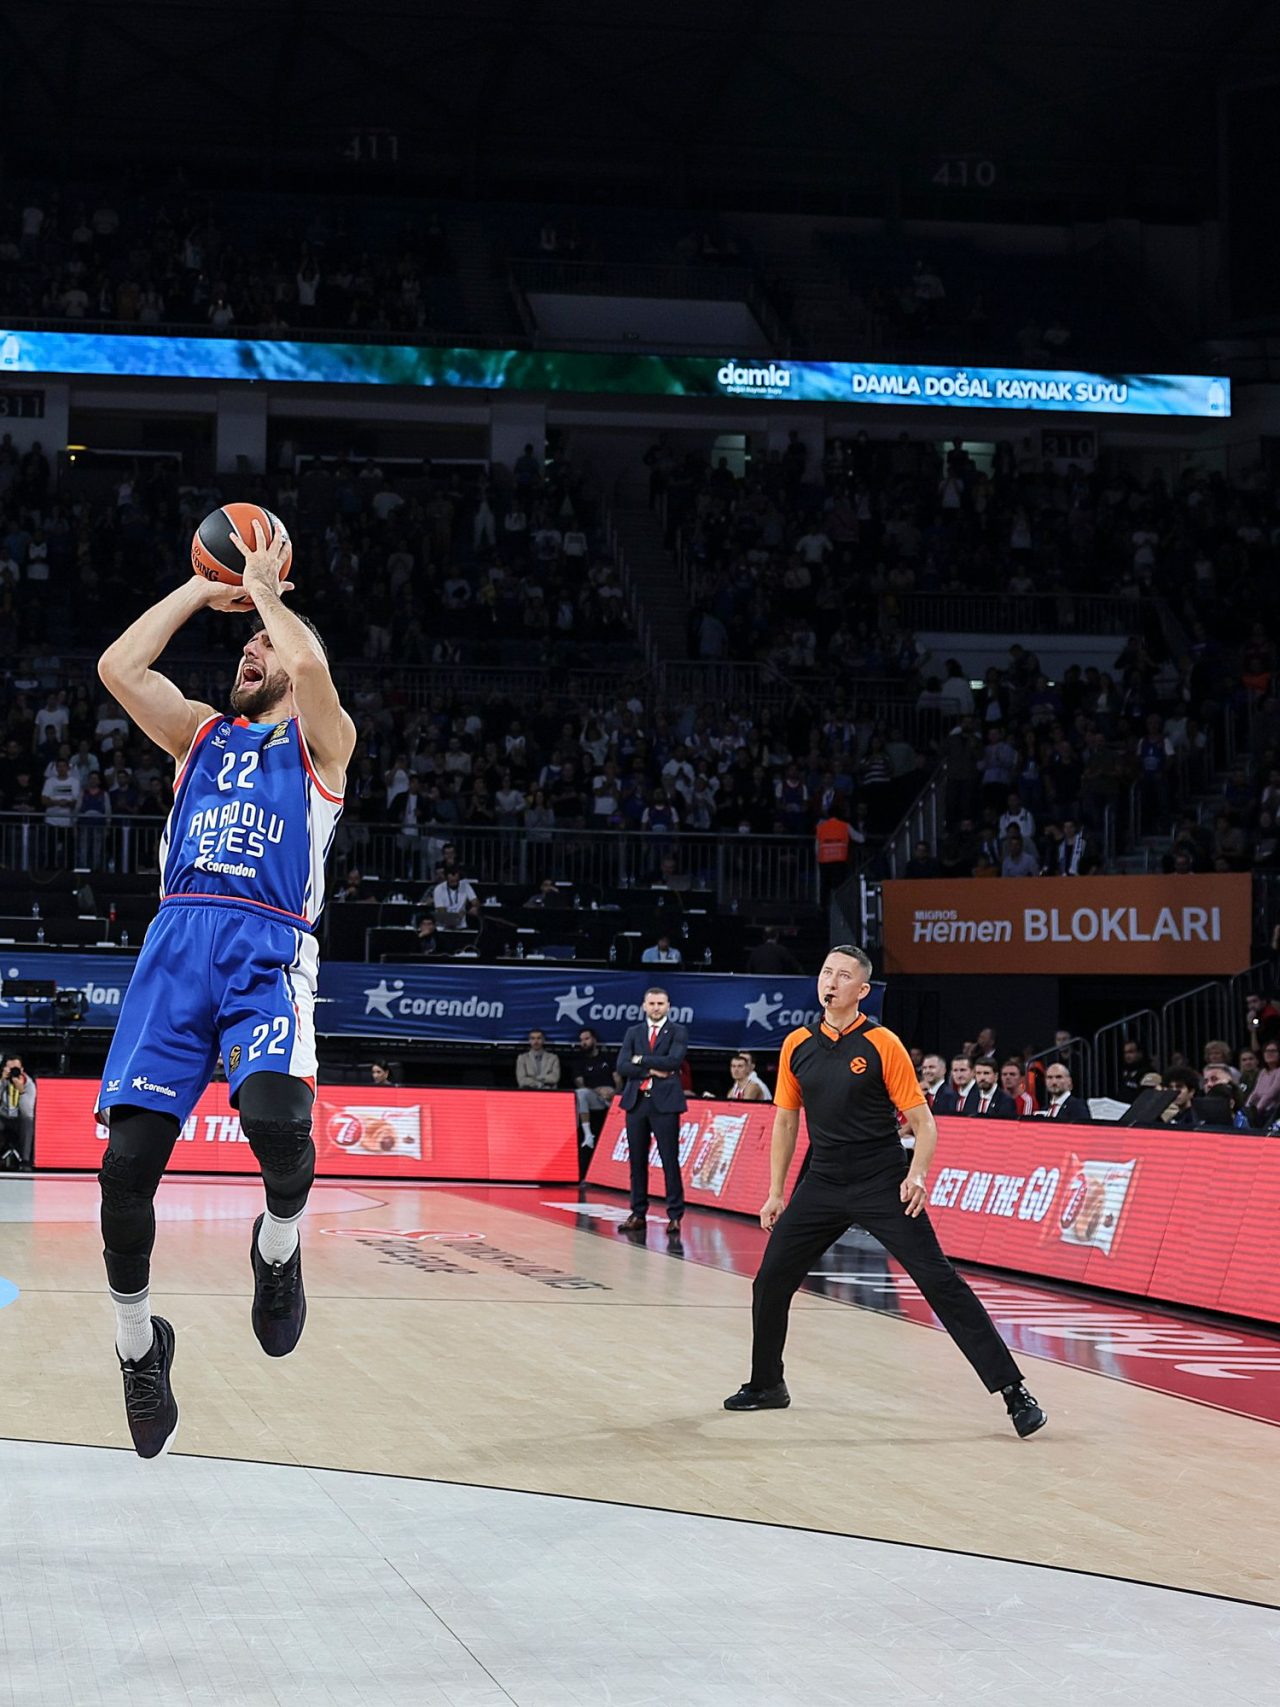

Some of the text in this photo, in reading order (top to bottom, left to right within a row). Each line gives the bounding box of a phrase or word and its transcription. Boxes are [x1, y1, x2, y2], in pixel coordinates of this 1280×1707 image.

[343, 135, 398, 162] 411
[932, 161, 996, 187] 410
[717, 362, 791, 387] damla
[853, 372, 1127, 404] DAMLA DOĞAL KAYNAK SUYU
[217, 751, 260, 791] 22
[189, 801, 284, 844] ANADOLU
[199, 827, 265, 858] EFES
[207, 861, 256, 879] corendon
[912, 906, 1220, 943] Hemen BLOKLARI
[399, 995, 504, 1019] corendon
[589, 1004, 694, 1024] coreon
[248, 1016, 290, 1062] 22
[144, 1082, 177, 1098] corendon
[176, 1115, 198, 1142] N
[930, 1166, 1061, 1222] GET ON THE GO
